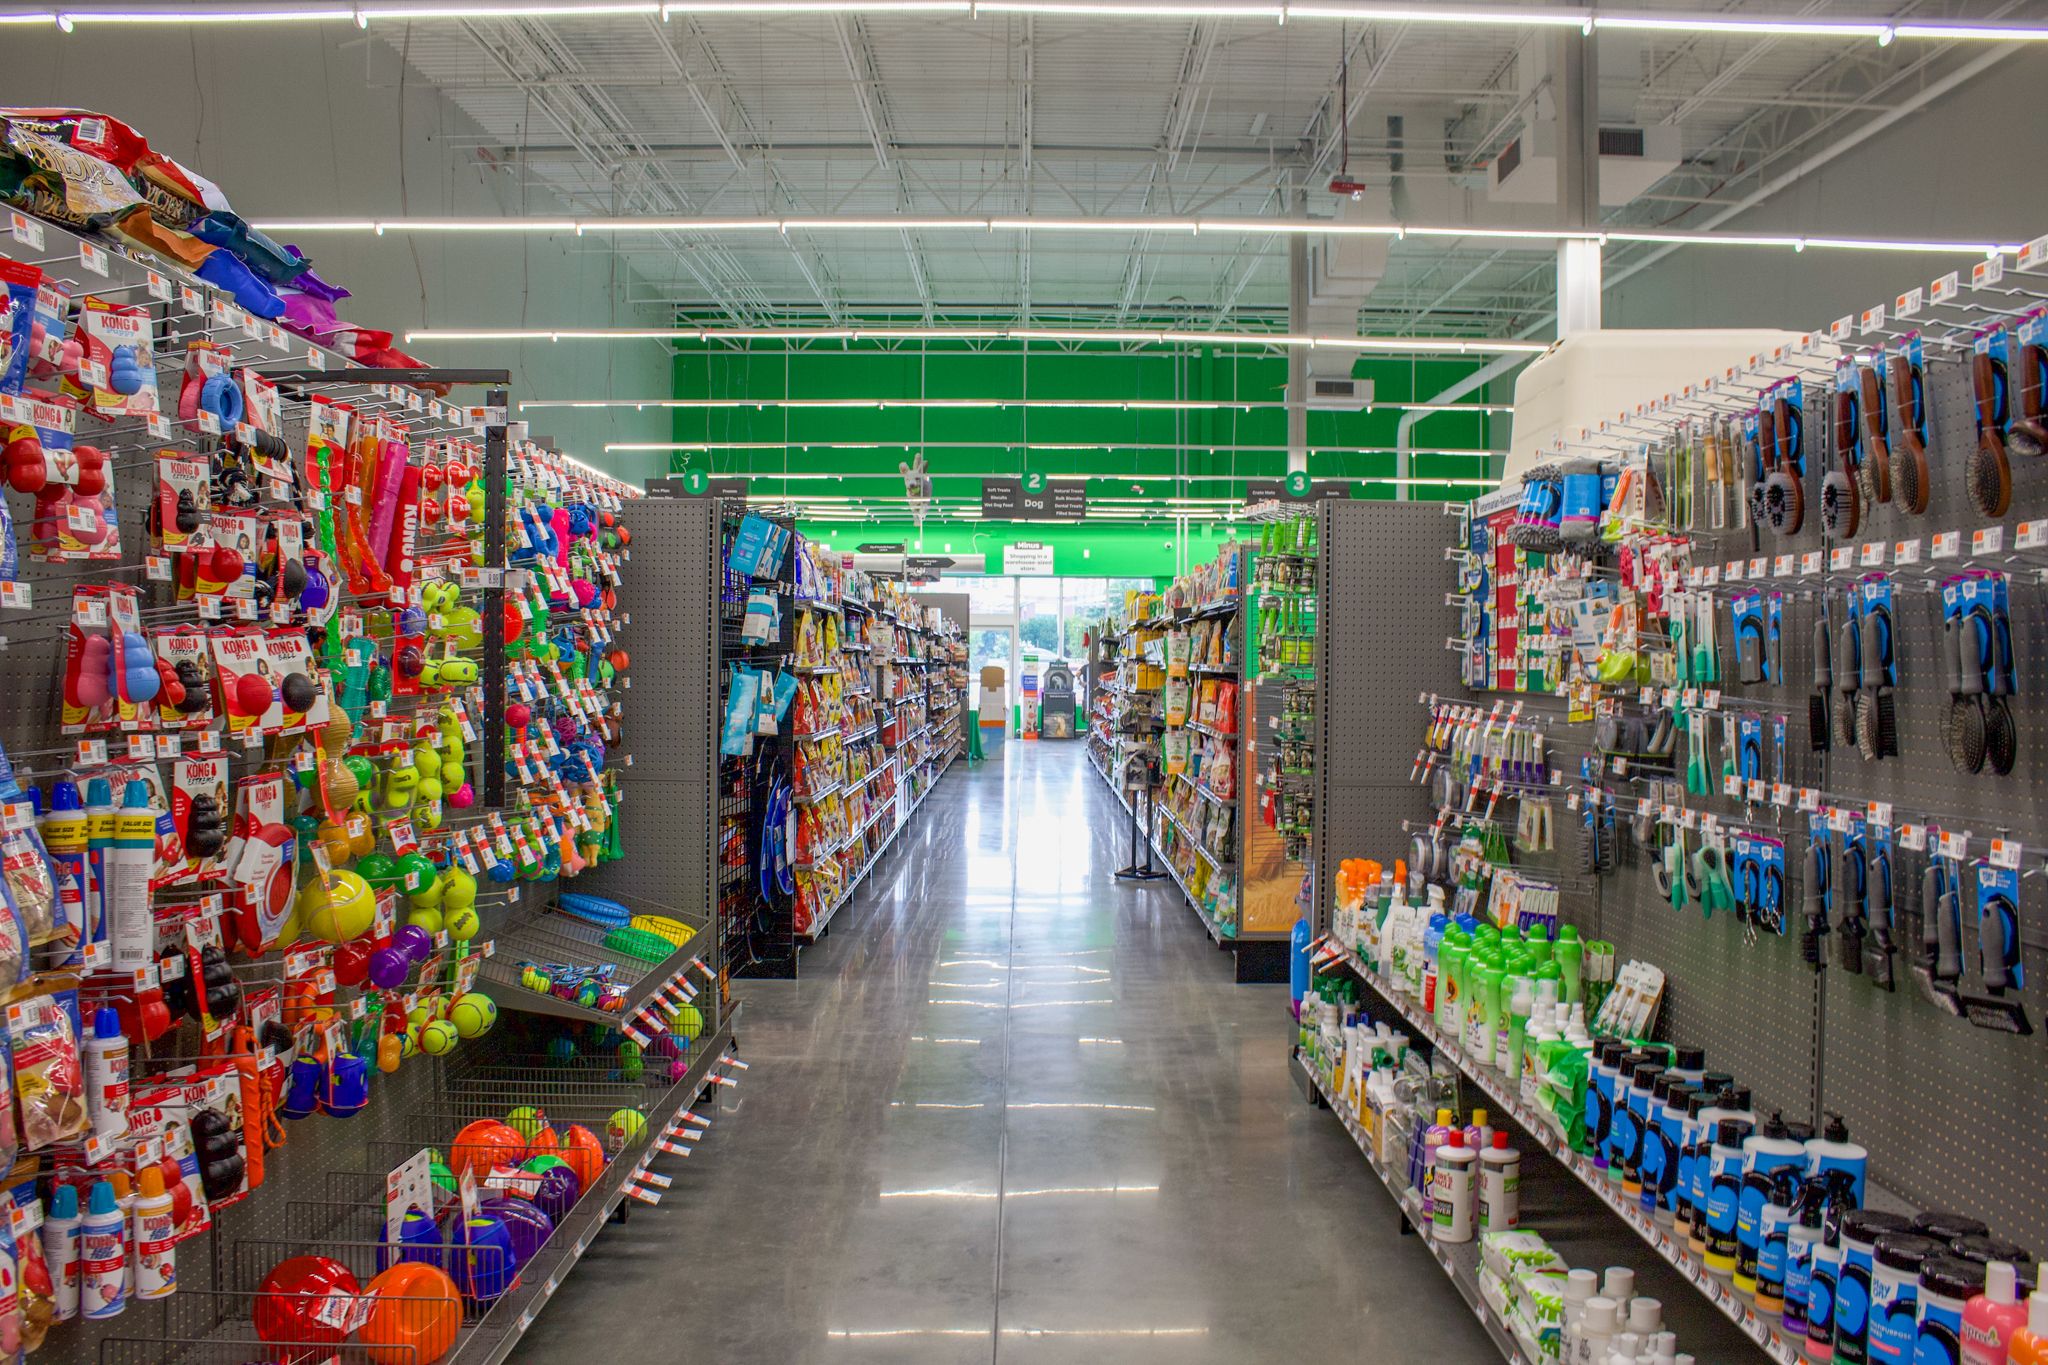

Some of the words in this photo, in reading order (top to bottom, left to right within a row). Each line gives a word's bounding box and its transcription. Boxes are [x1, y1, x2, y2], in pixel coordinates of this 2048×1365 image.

[147, 187, 183, 217] VICTOR
[101, 316, 131, 331] KONG
[33, 404, 56, 422] KONG
[170, 462, 193, 475] KONG
[690, 474, 698, 488] 1
[1028, 473, 1040, 488] 2
[1293, 476, 1305, 491] 3
[1024, 498, 1044, 510] Dog
[212, 517, 237, 529] KONG
[400, 504, 418, 556] KONG
[168, 638, 192, 650] KONG
[222, 640, 250, 654] KONG
[266, 641, 295, 658] KONG
[186, 762, 210, 778] KONG
[188, 776, 215, 786] EXTREME
[255, 786, 272, 800] KONG
[159, 926, 178, 938] KONG
[184, 1086, 206, 1103] KON
[86, 1235, 116, 1250] KONG
